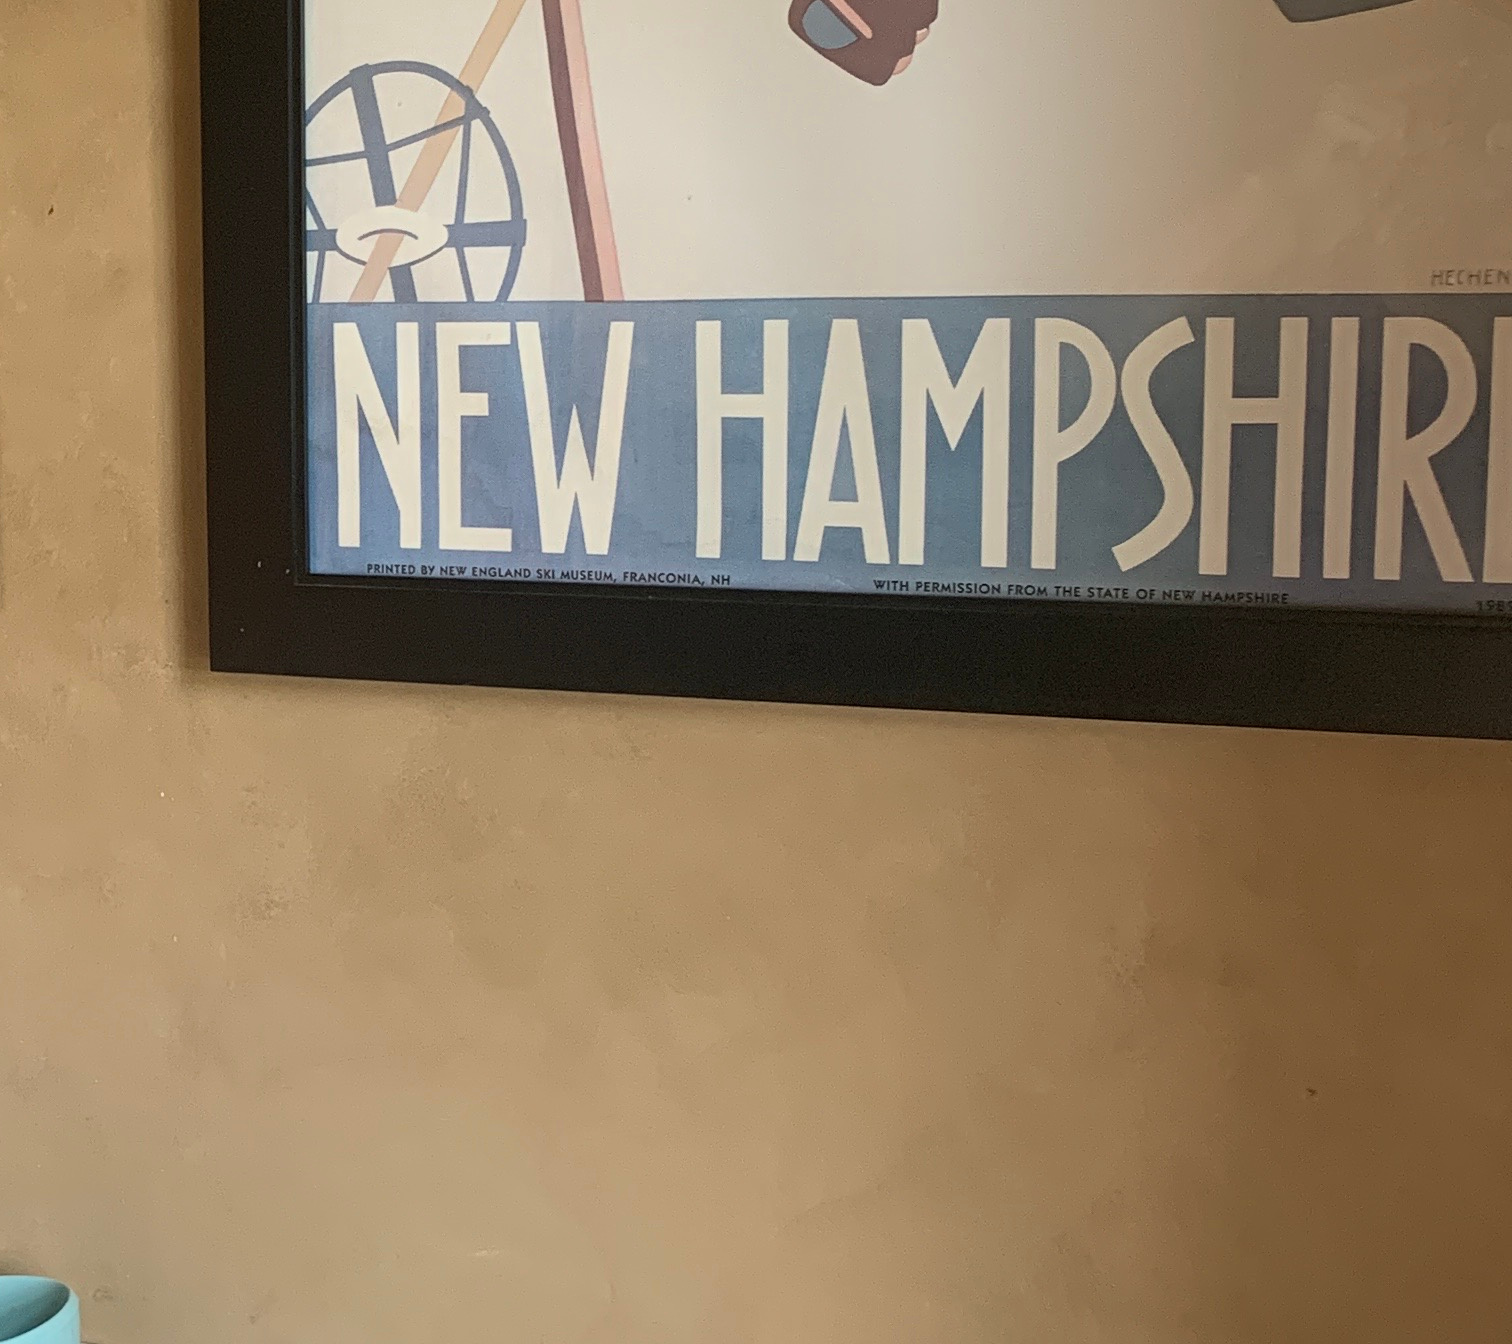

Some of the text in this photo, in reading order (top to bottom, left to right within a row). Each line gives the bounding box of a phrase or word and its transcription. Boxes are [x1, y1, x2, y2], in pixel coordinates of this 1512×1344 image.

[333, 320, 634, 556] NEW
[366, 562, 732, 587] PRINTED BY NEW ENGLAND SKI MUSEUM, FRANCONIA, NH
[872, 579, 1290, 605] WITH PERMISSION FROM THE STATE OF NEW HAMPSHIRE
